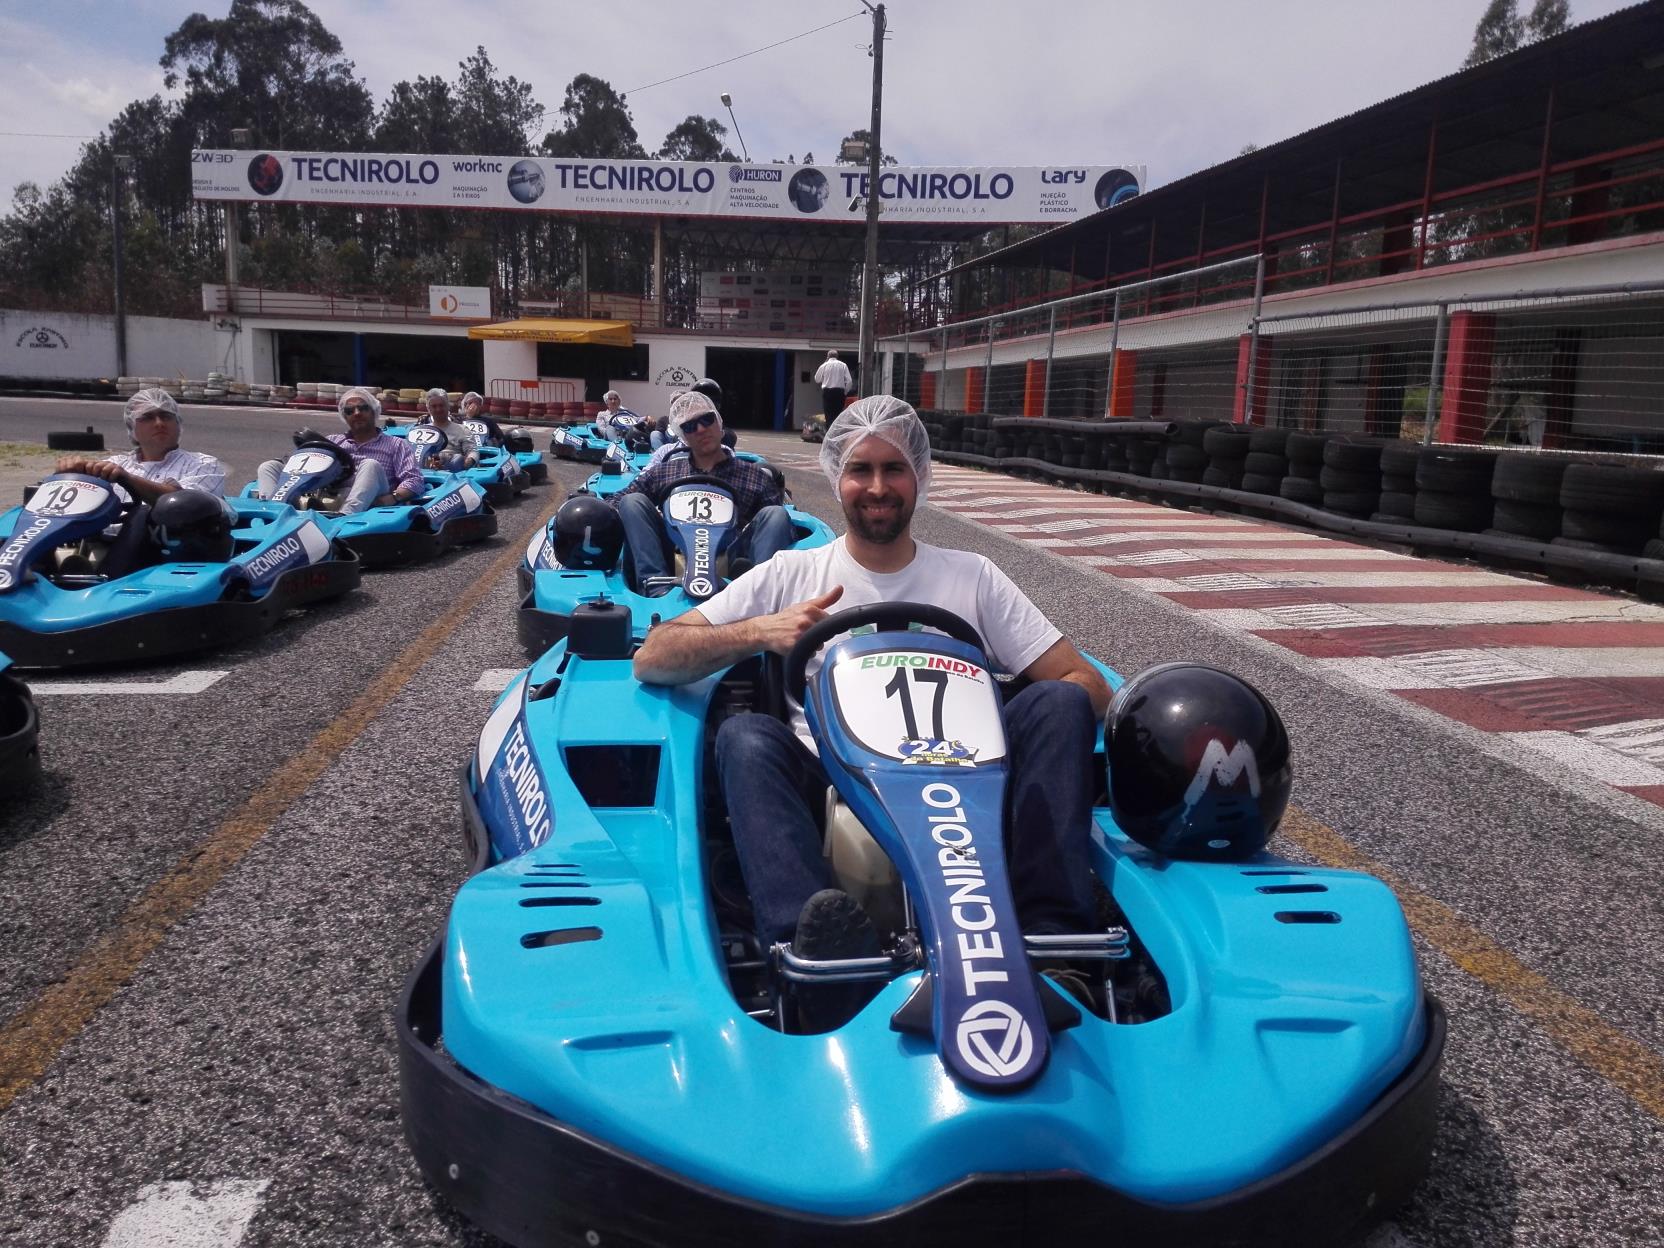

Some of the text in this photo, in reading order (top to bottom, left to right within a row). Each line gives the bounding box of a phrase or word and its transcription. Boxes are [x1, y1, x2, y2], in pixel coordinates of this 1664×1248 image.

[291, 157, 439, 185] TECNIROLO
[555, 164, 715, 194] TECNIROLO
[747, 170, 780, 181] HURON
[677, 366, 698, 383] KARTIN
[416, 430, 436, 442] 27
[469, 423, 484, 433] 28
[44, 485, 79, 510] 19
[687, 496, 713, 520] 13
[246, 537, 301, 580] TECNIROLO
[860, 655, 981, 678] EUROINDY
[885, 666, 949, 742] 17
[1183, 737, 1262, 806] M
[920, 782, 1009, 997] TECNIROLO
